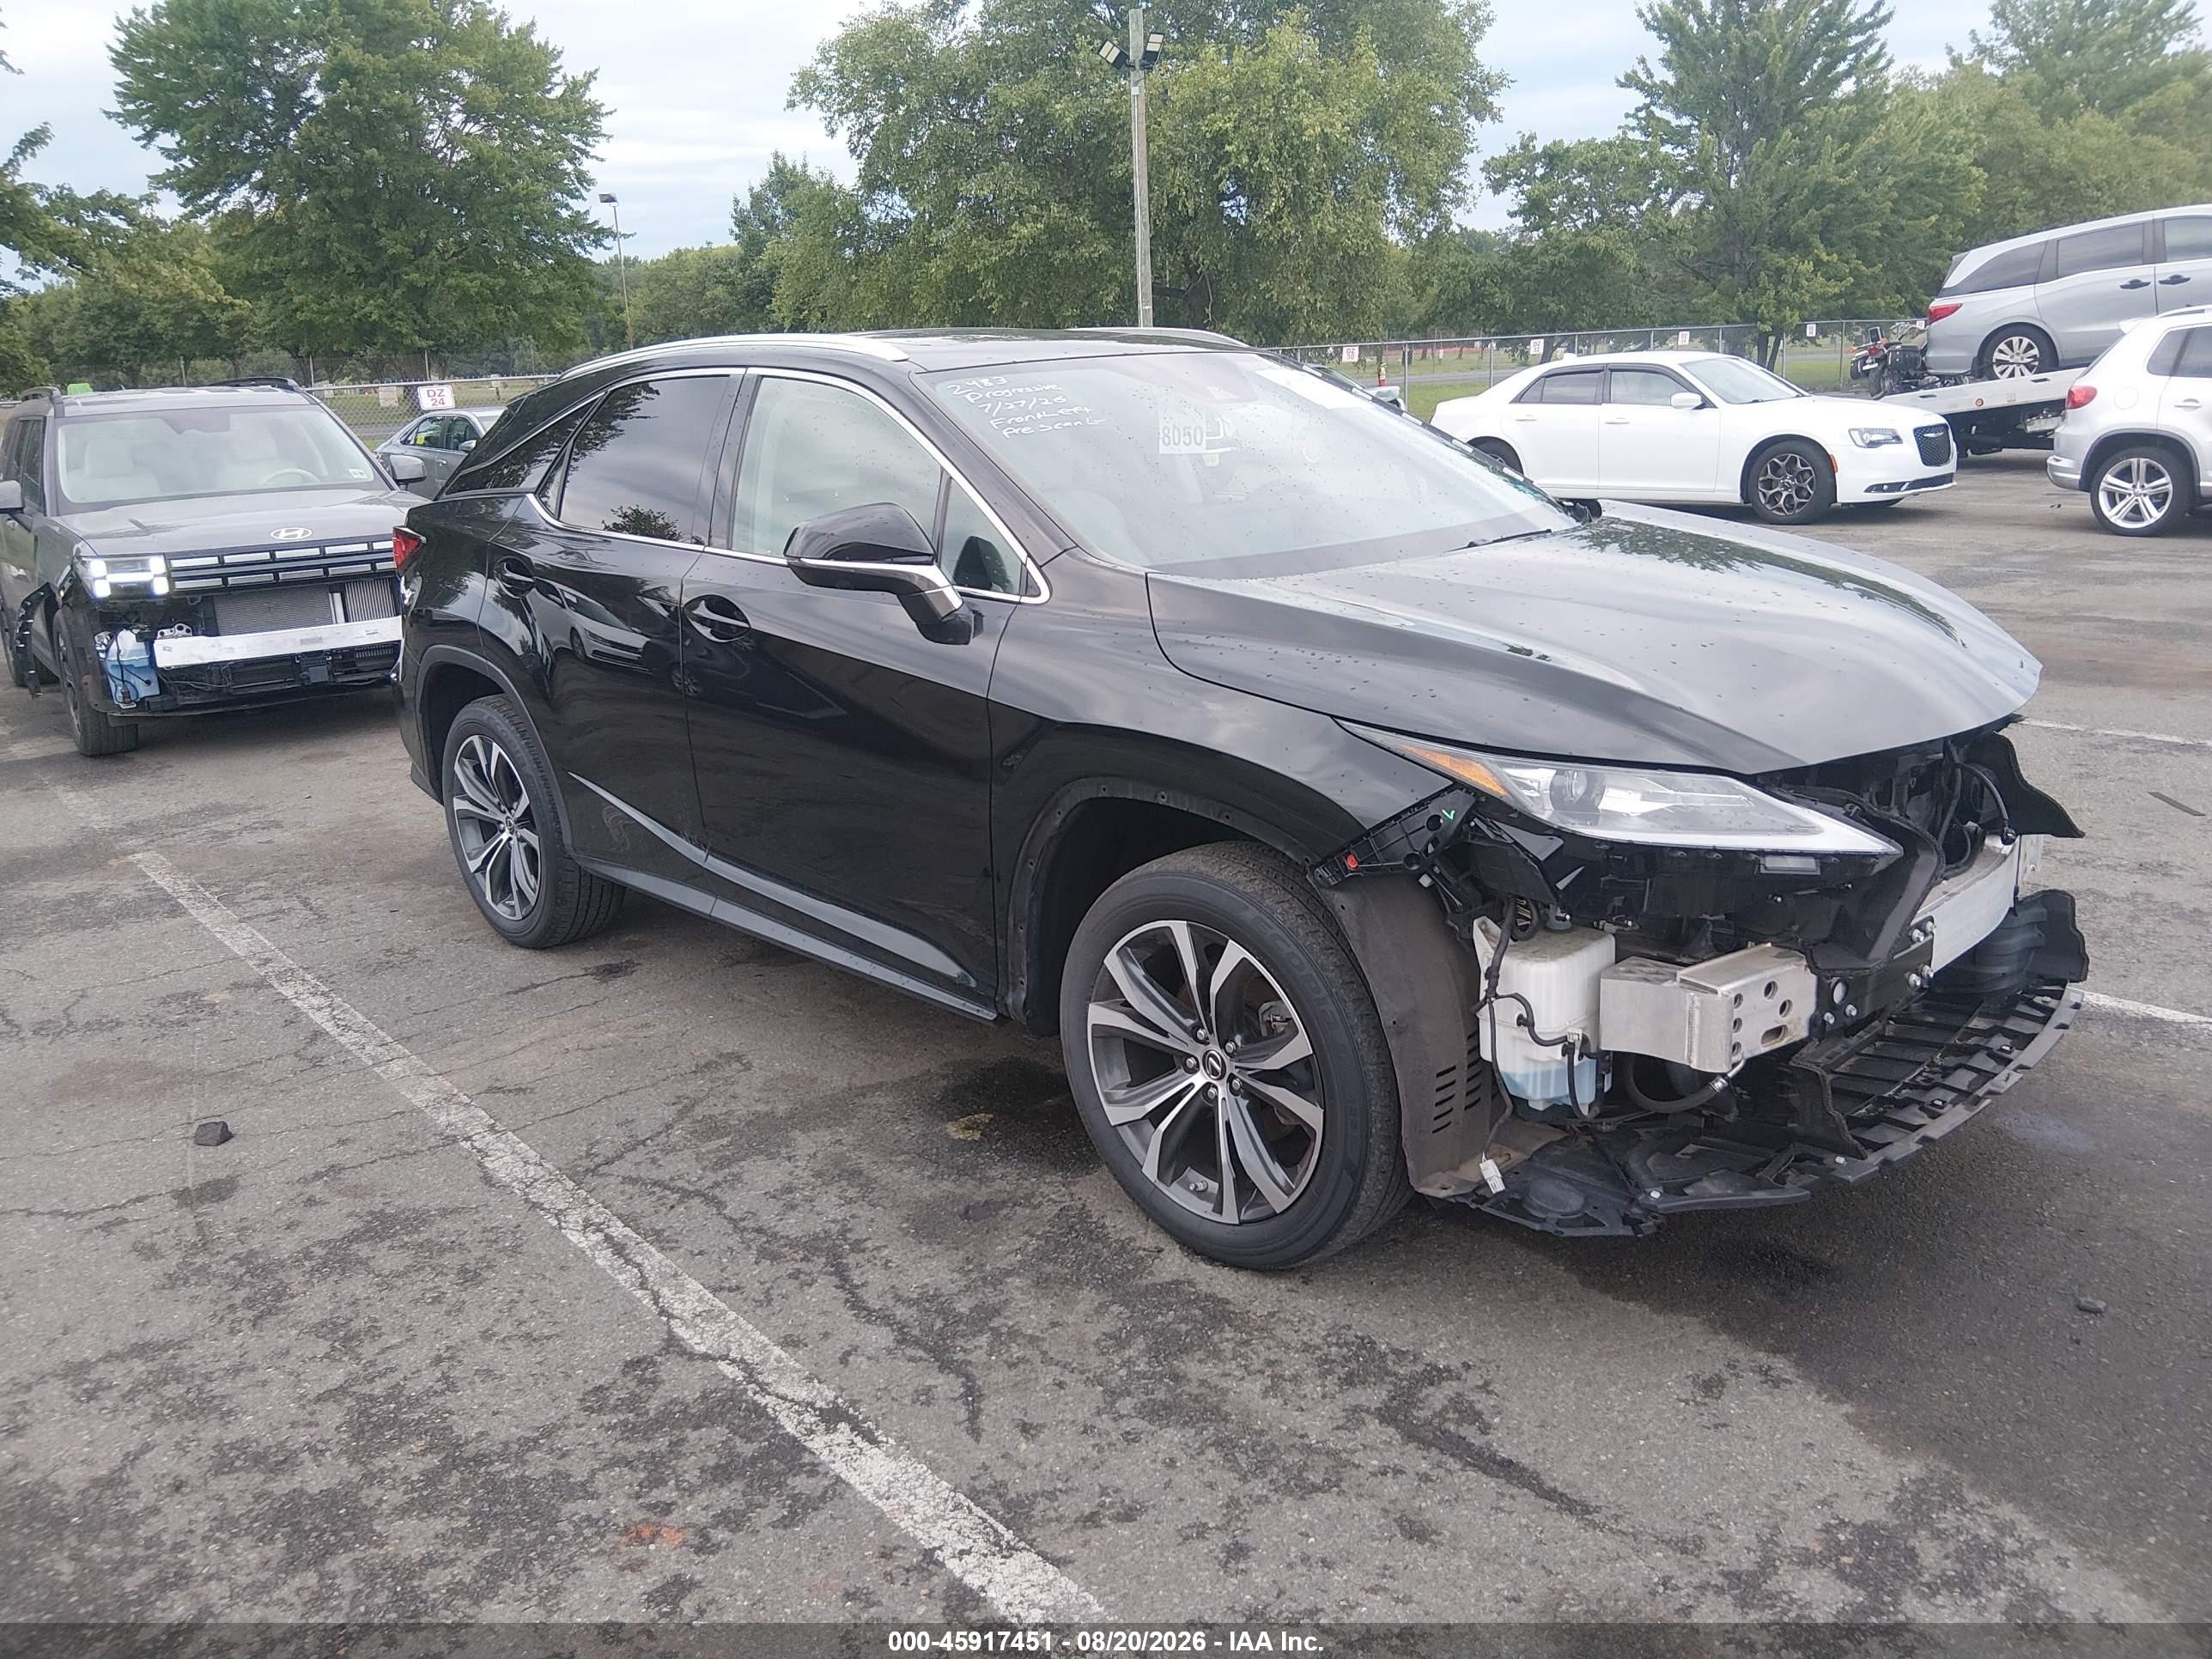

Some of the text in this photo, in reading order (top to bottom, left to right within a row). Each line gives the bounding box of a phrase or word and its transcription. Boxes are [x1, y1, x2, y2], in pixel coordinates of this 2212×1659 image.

[948, 376, 1006, 395] 2483
[427, 389, 446, 398] DZ
[431, 398, 446, 406] 24
[1162, 425, 1203, 447] 8050
